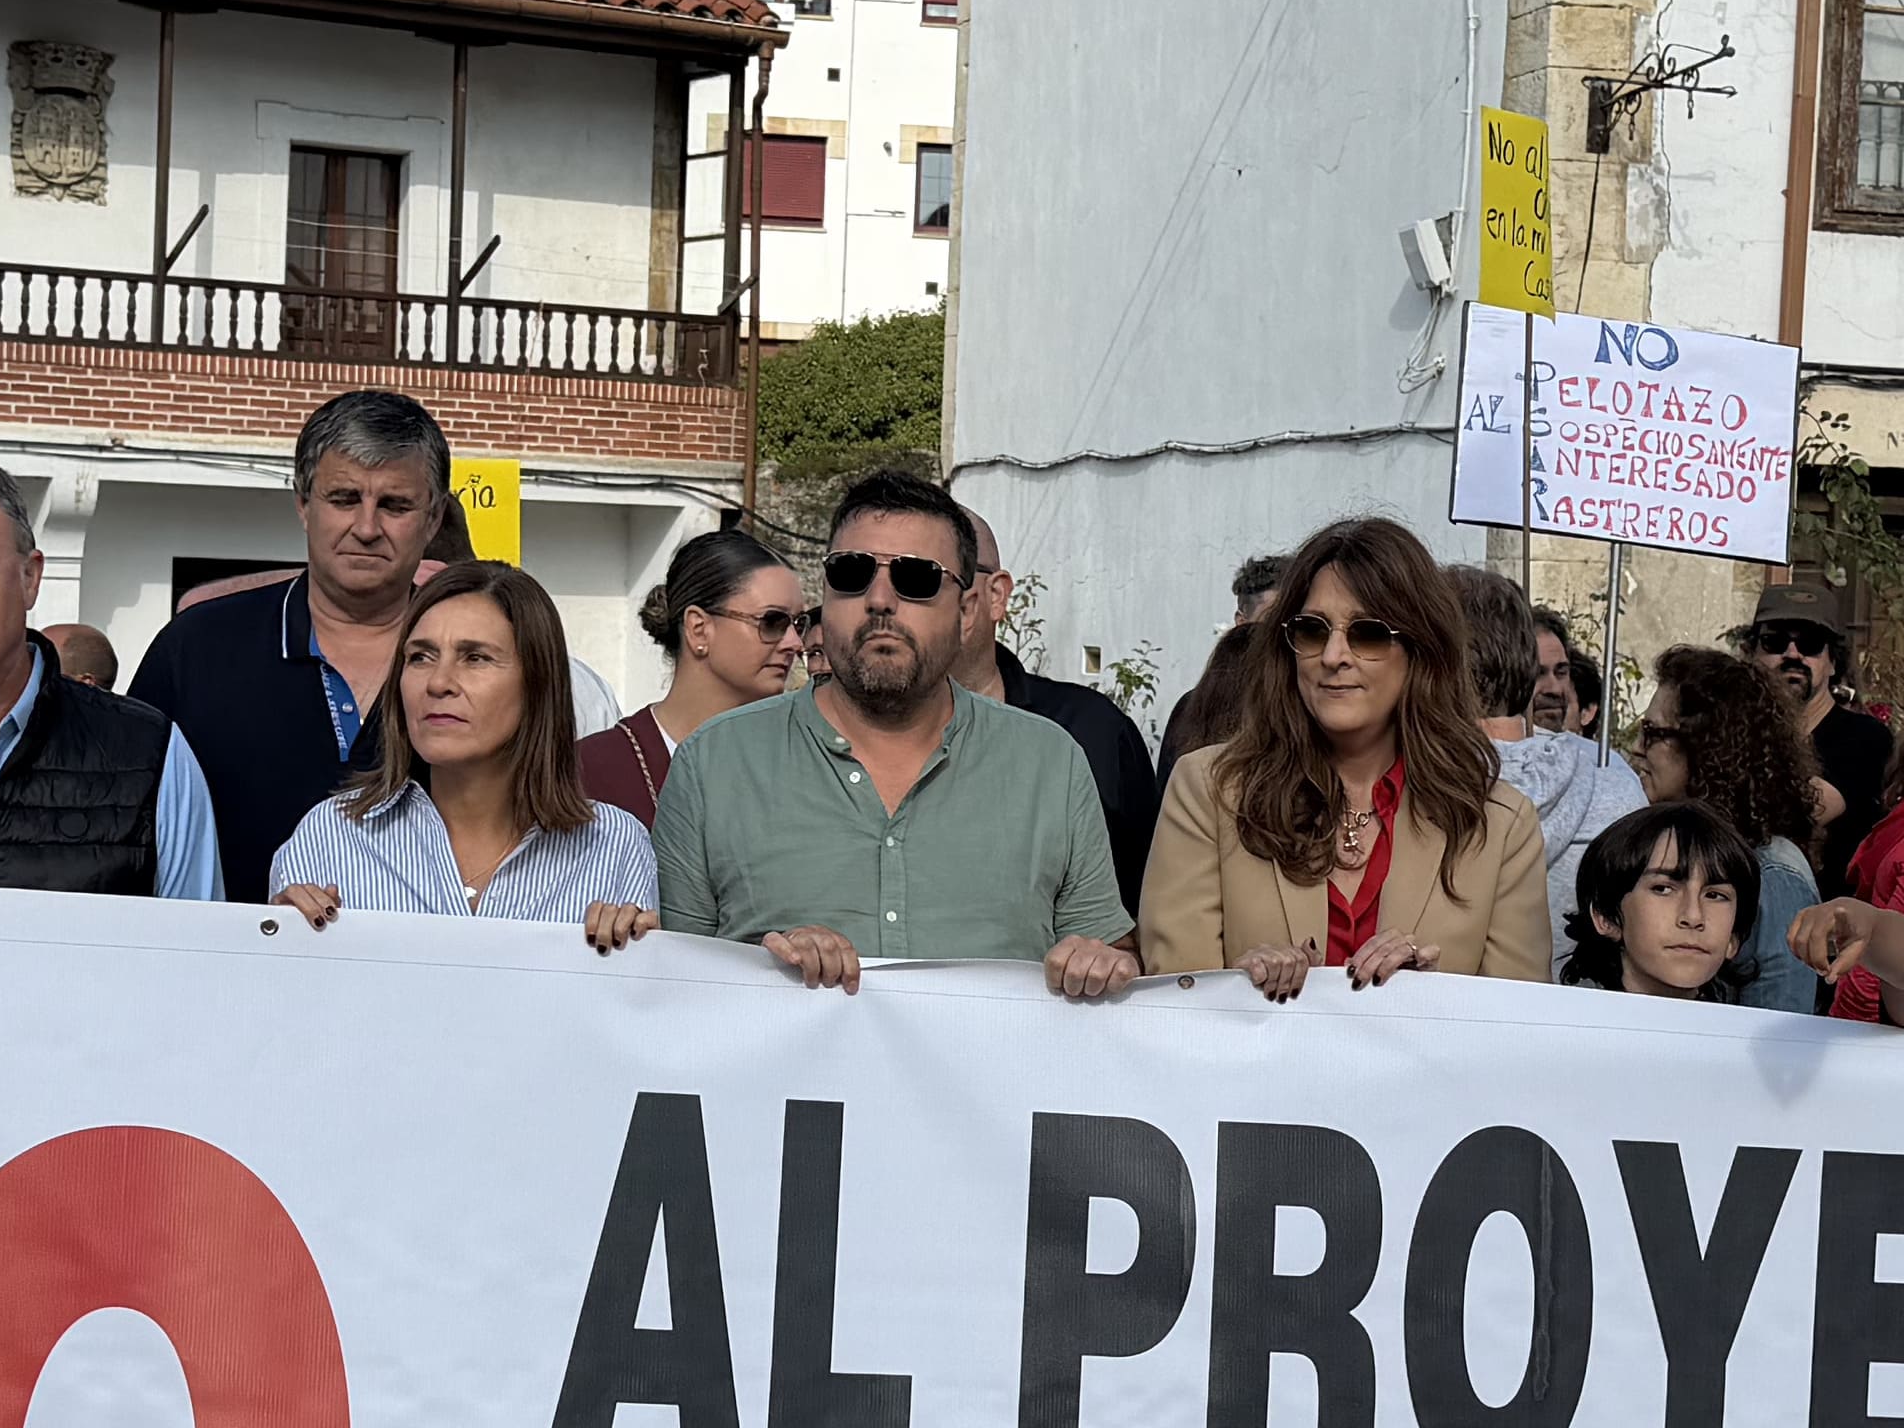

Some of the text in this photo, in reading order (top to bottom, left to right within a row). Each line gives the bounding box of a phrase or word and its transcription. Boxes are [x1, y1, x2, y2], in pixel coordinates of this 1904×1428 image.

[1488, 120, 1515, 166] No
[1595, 320, 1679, 371] NO
[1464, 394, 1510, 433] AL
